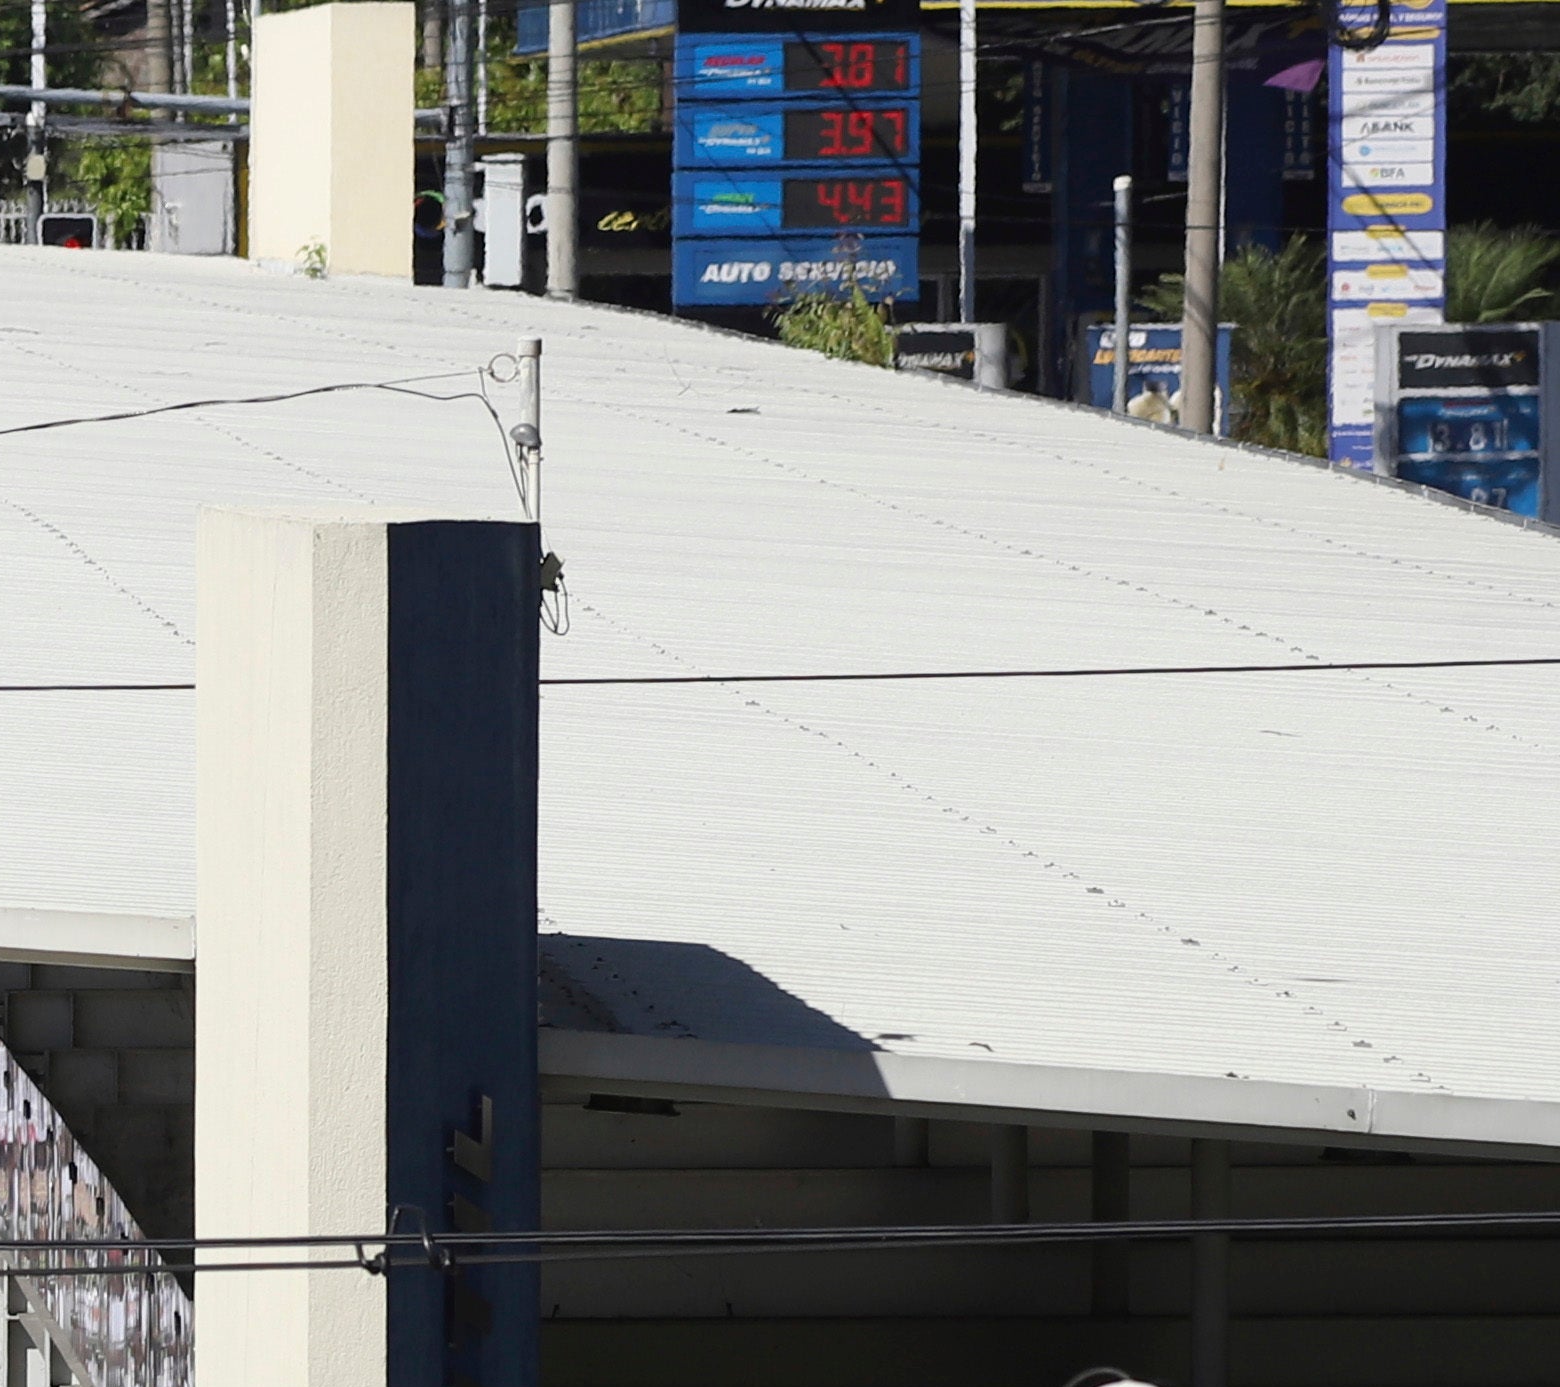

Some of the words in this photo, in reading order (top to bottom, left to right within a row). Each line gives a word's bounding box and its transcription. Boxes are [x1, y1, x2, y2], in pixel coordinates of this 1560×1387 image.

[1380, 167, 1405, 179] BFA
[701, 261, 772, 284] AUTO
[1416, 351, 1513, 373] DYNAMAX
